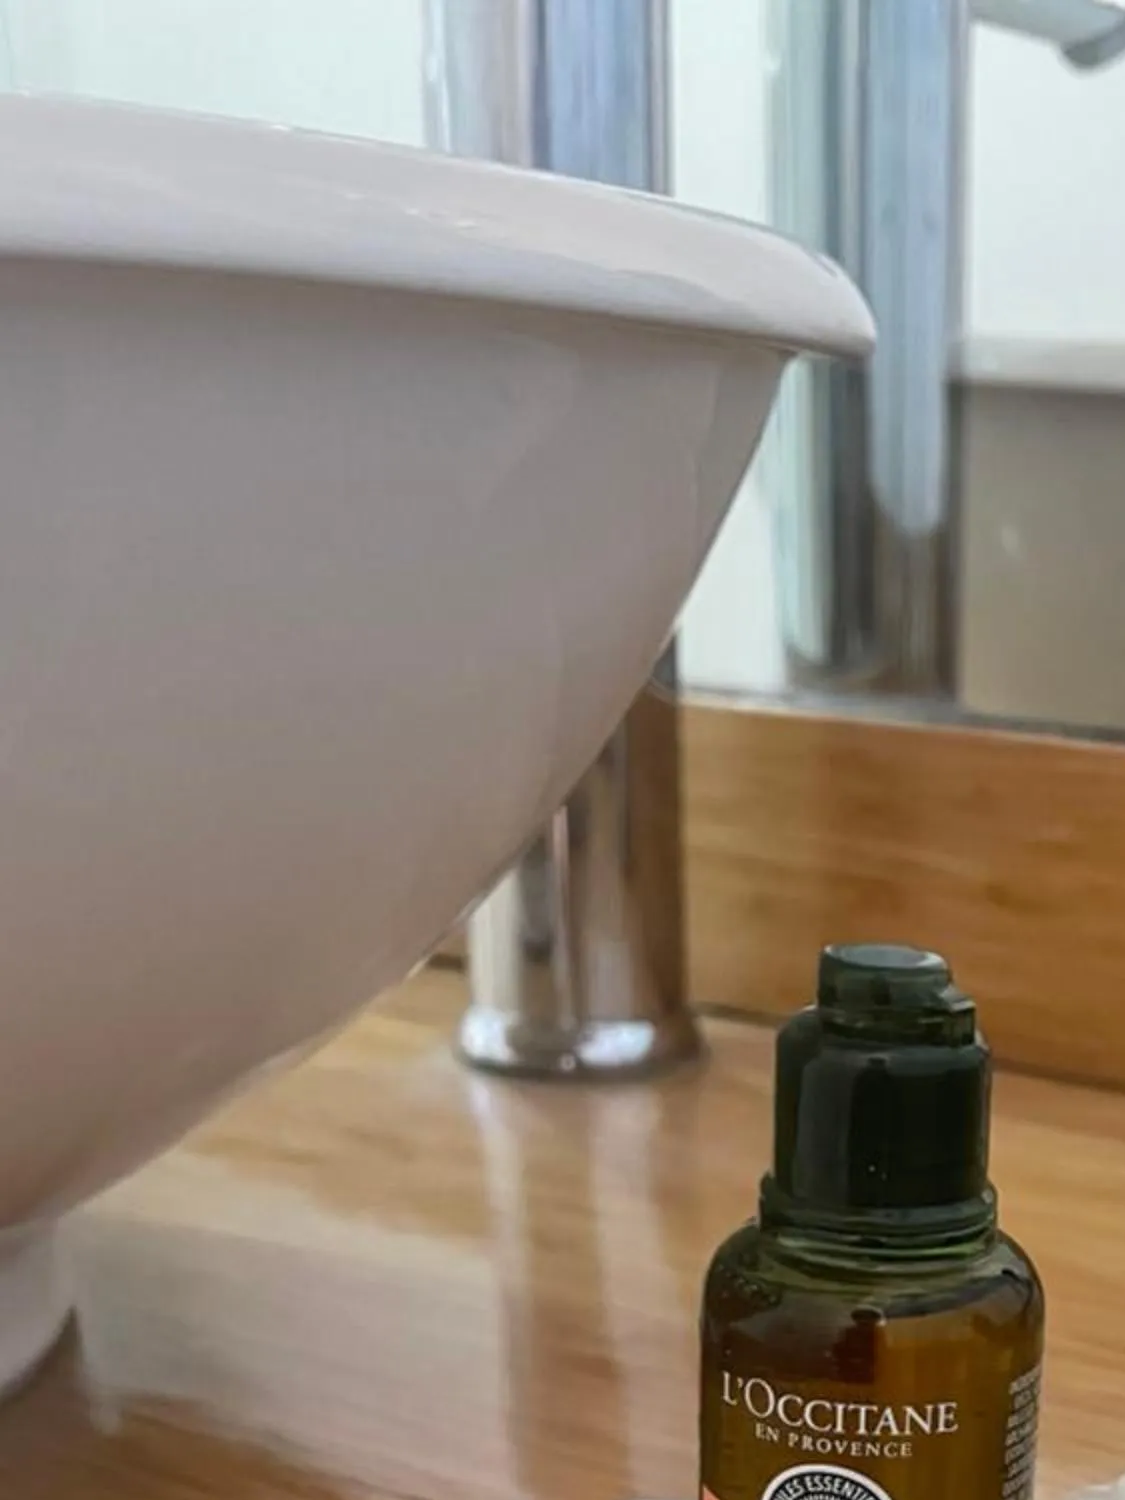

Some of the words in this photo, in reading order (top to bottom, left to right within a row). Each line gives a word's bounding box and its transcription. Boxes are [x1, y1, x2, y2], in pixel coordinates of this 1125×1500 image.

[721, 1370, 959, 1437] L'OCCITANE
[755, 1423, 779, 1442] EN
[787, 1432, 912, 1458] PROVENCE
